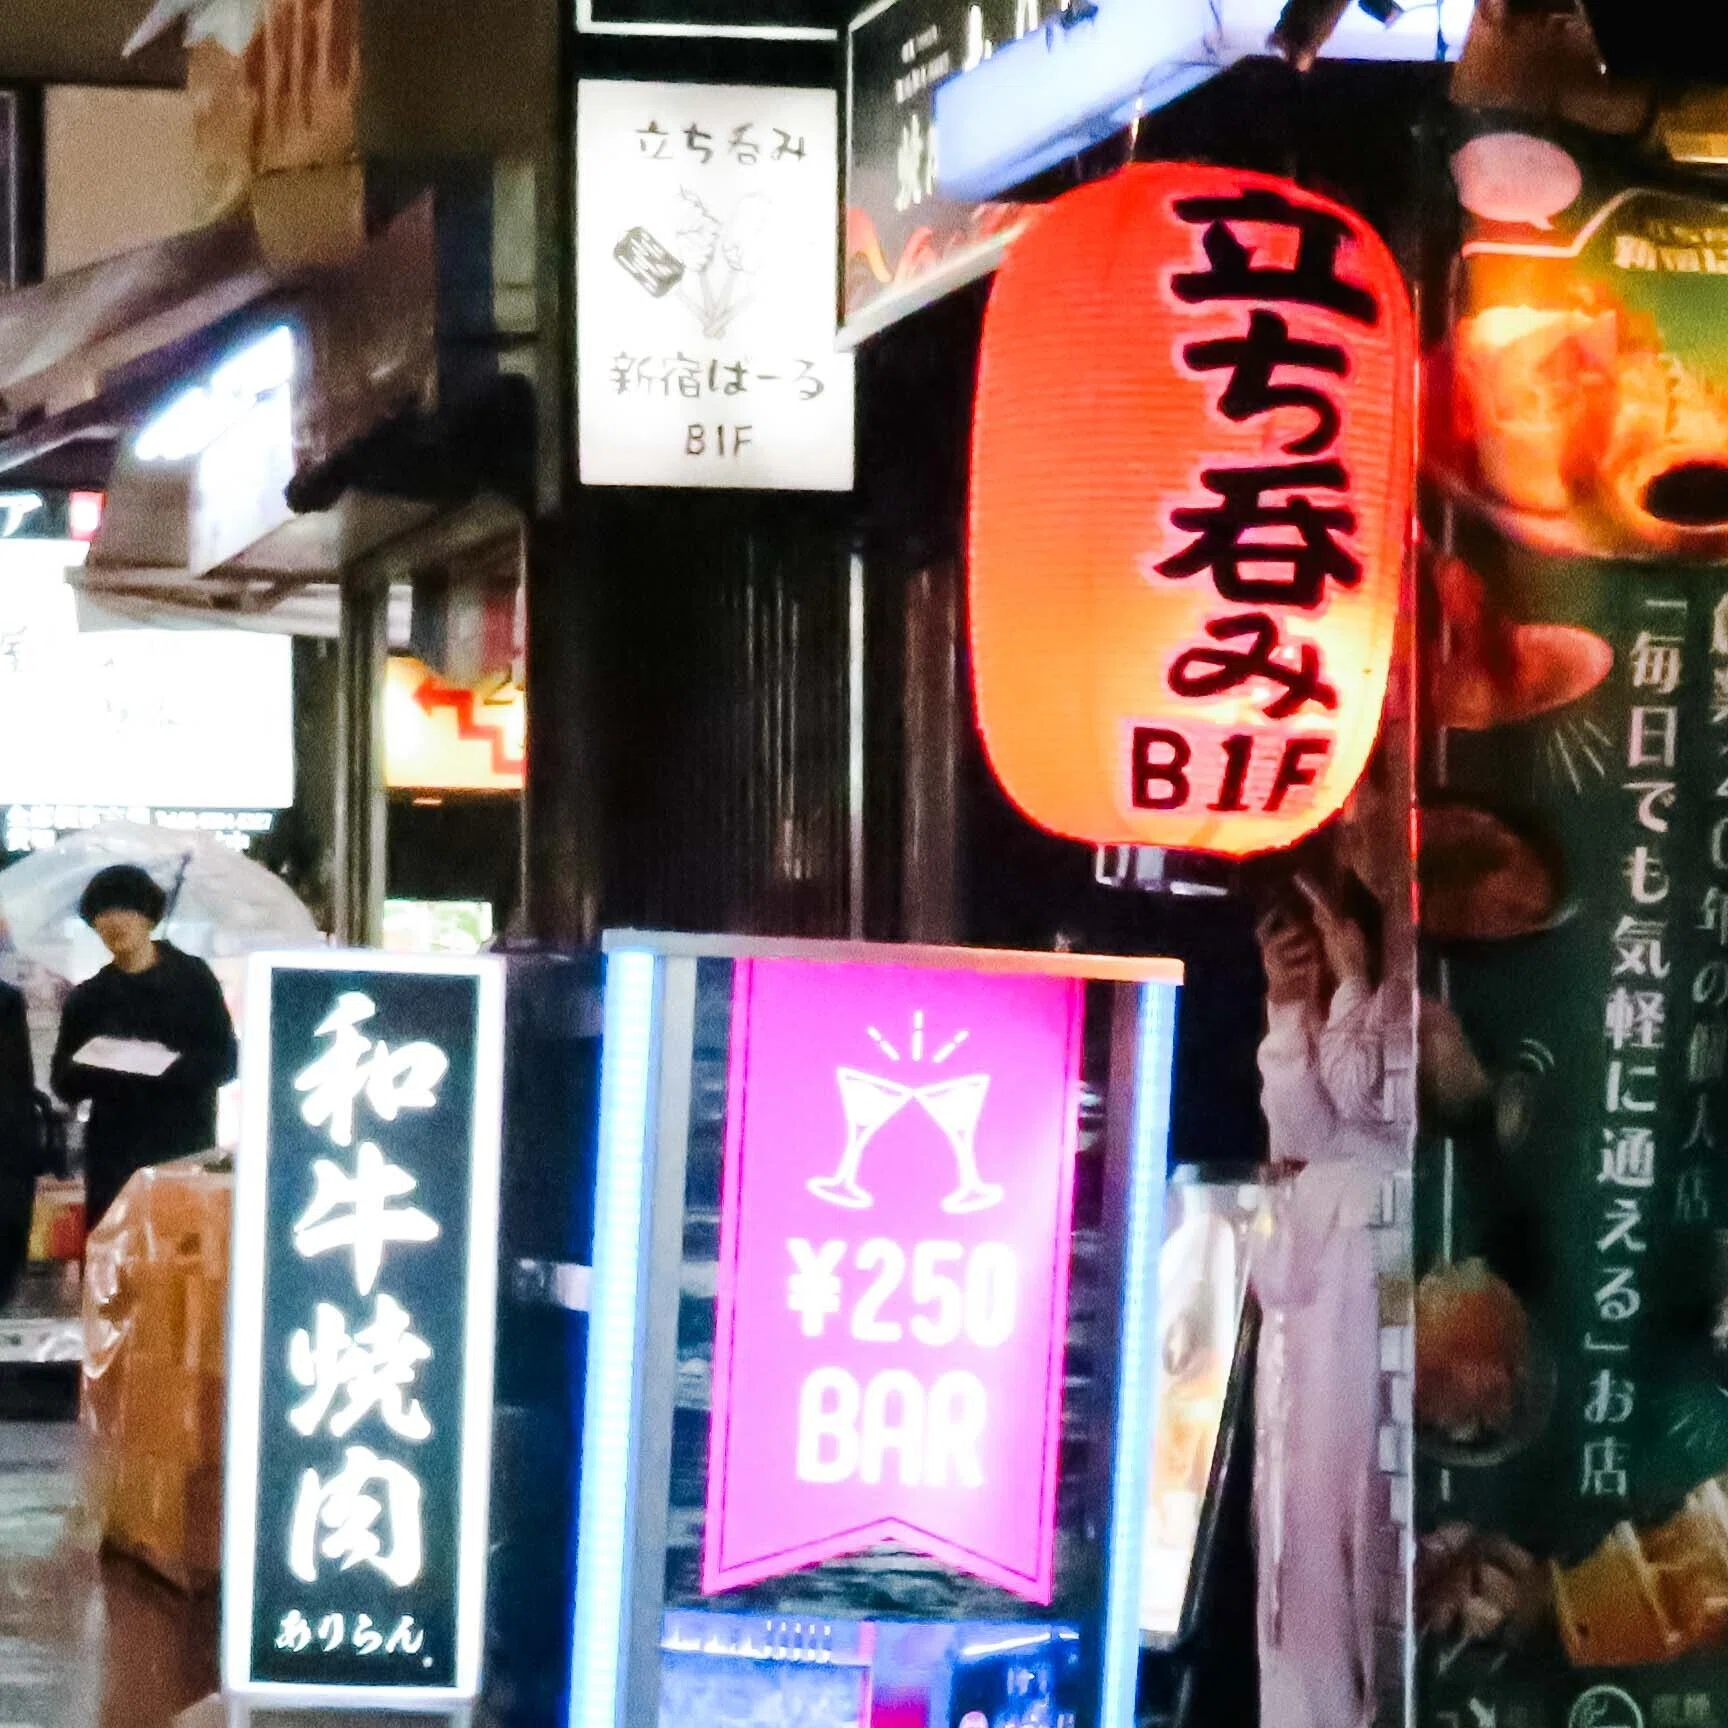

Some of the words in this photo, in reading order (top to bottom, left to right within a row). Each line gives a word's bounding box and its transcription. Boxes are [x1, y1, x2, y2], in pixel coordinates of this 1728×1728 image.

[634, 120, 808, 165] 立ち呑み
[609, 351, 825, 400] 新宿ばーる
[684, 423, 753, 457] B1F
[1152, 187, 1379, 716] 立ち呑み
[1131, 726, 1330, 814] B1F
[288, 991, 450, 1588] 和牛焼肉
[785, 1237, 1018, 1348] ¥250
[796, 1365, 986, 1489] BAR
